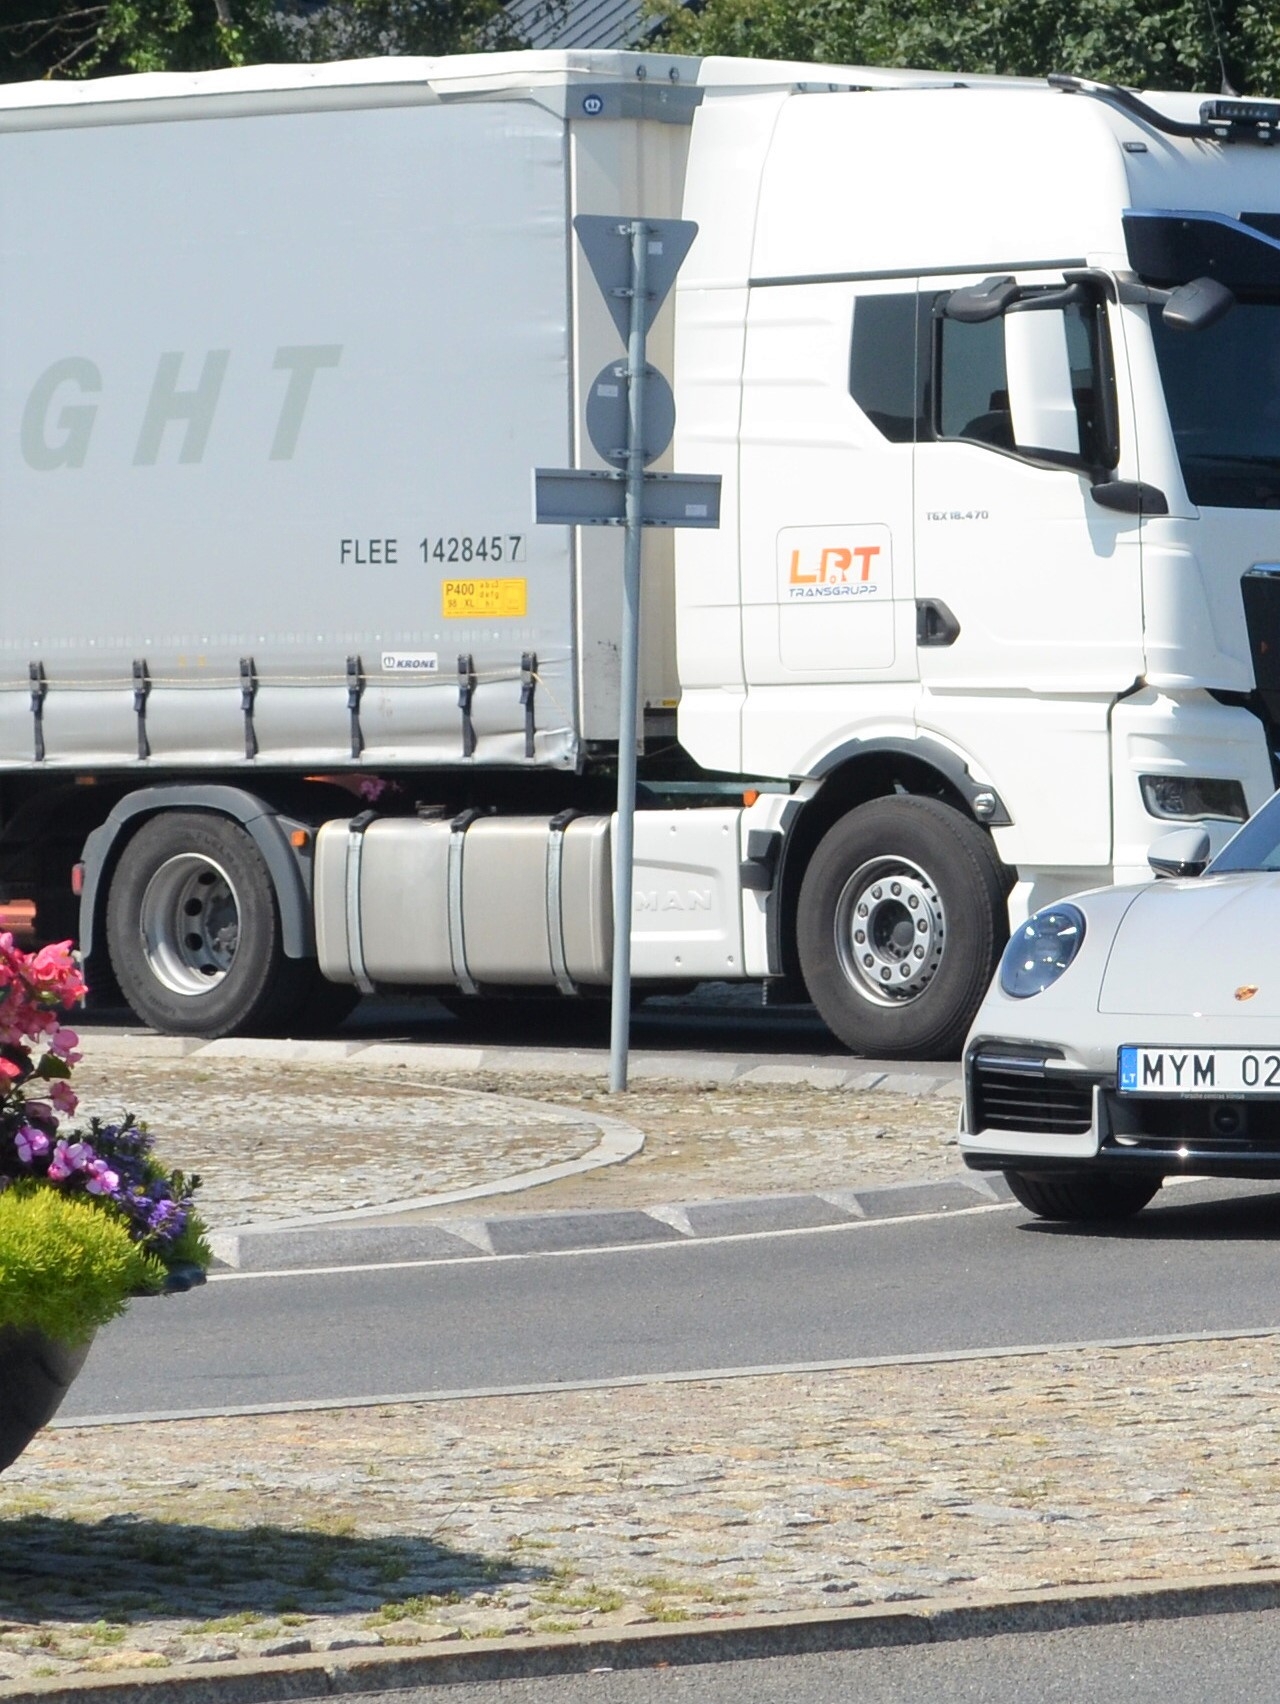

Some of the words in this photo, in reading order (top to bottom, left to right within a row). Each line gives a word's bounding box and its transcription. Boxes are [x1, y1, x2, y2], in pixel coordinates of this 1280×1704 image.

[926, 511, 947, 521] TGX
[950, 510, 989, 520] 18.470
[341, 539, 398, 564] FLEE
[419, 536, 522, 563] 1428457
[789, 546, 880, 584] LRT
[446, 583, 475, 596] P400
[789, 585, 877, 597] TRANSGRUPP
[397, 659, 435, 668] KRONE
[635, 890, 711, 911] MAN
[1143, 1054, 1215, 1086] MYM
[1122, 1074, 1136, 1084] LT
